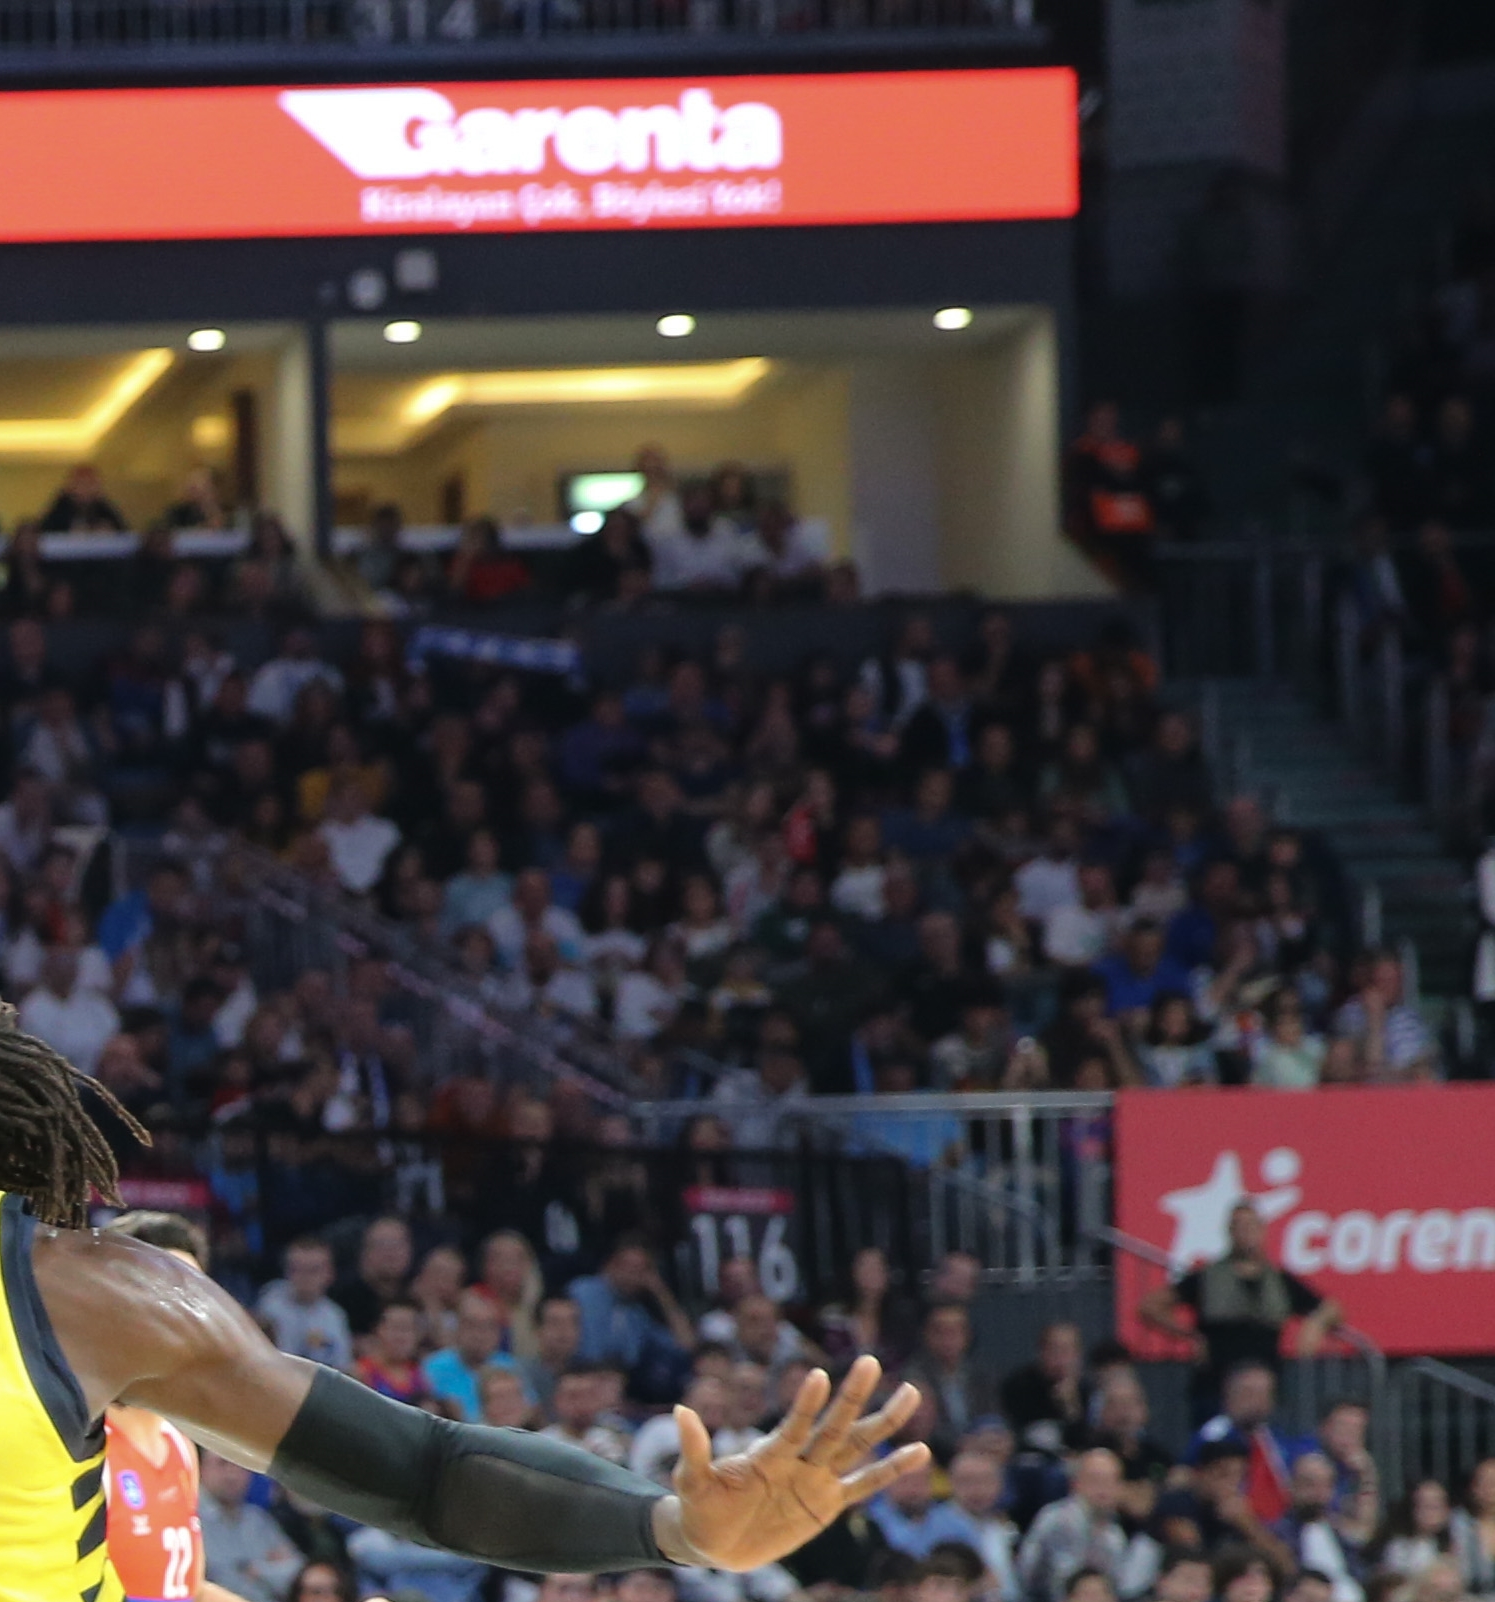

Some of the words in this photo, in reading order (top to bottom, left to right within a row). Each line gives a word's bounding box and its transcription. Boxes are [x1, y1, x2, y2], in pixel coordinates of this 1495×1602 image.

[279, 87, 783, 179] Garenta
[1282, 1208, 1495, 1276] coren
[162, 1526, 193, 1599] 22
